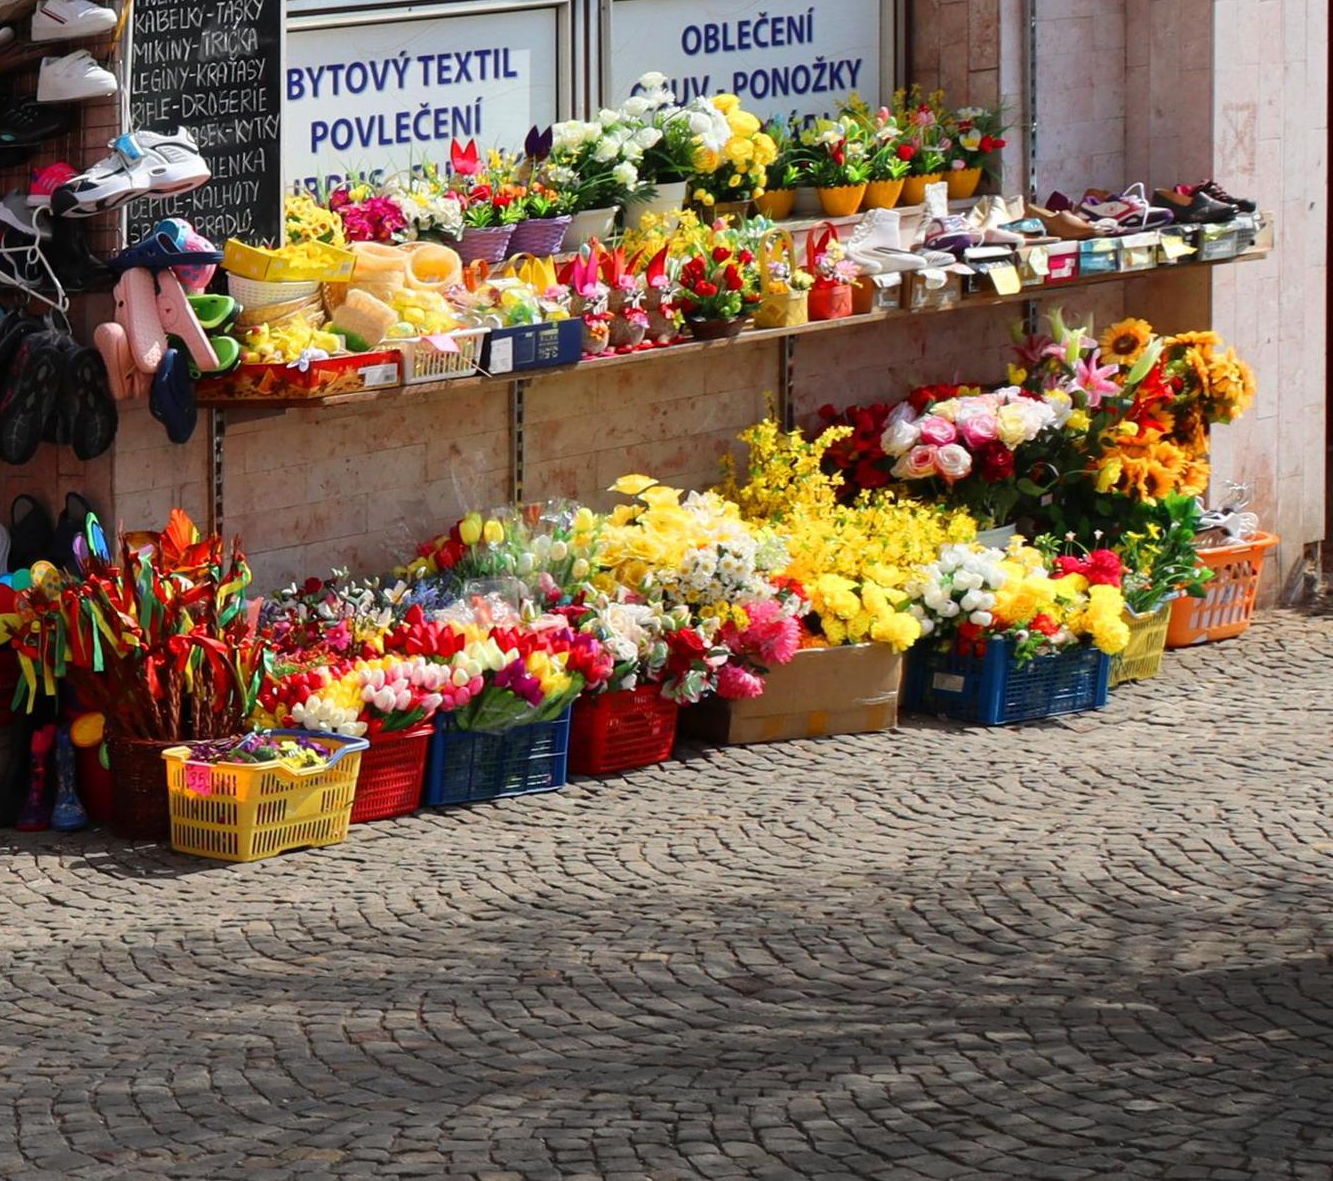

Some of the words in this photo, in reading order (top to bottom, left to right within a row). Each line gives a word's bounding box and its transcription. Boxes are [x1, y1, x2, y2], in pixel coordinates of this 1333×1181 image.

[680, 7, 815, 56] OBLEČENÍ
[286, 49, 409, 100] BYTOVÝ
[418, 47, 518, 88] TEXTIL
[733, 56, 862, 101] PONOŽKY
[310, 98, 483, 154] POVLEČENÍ
